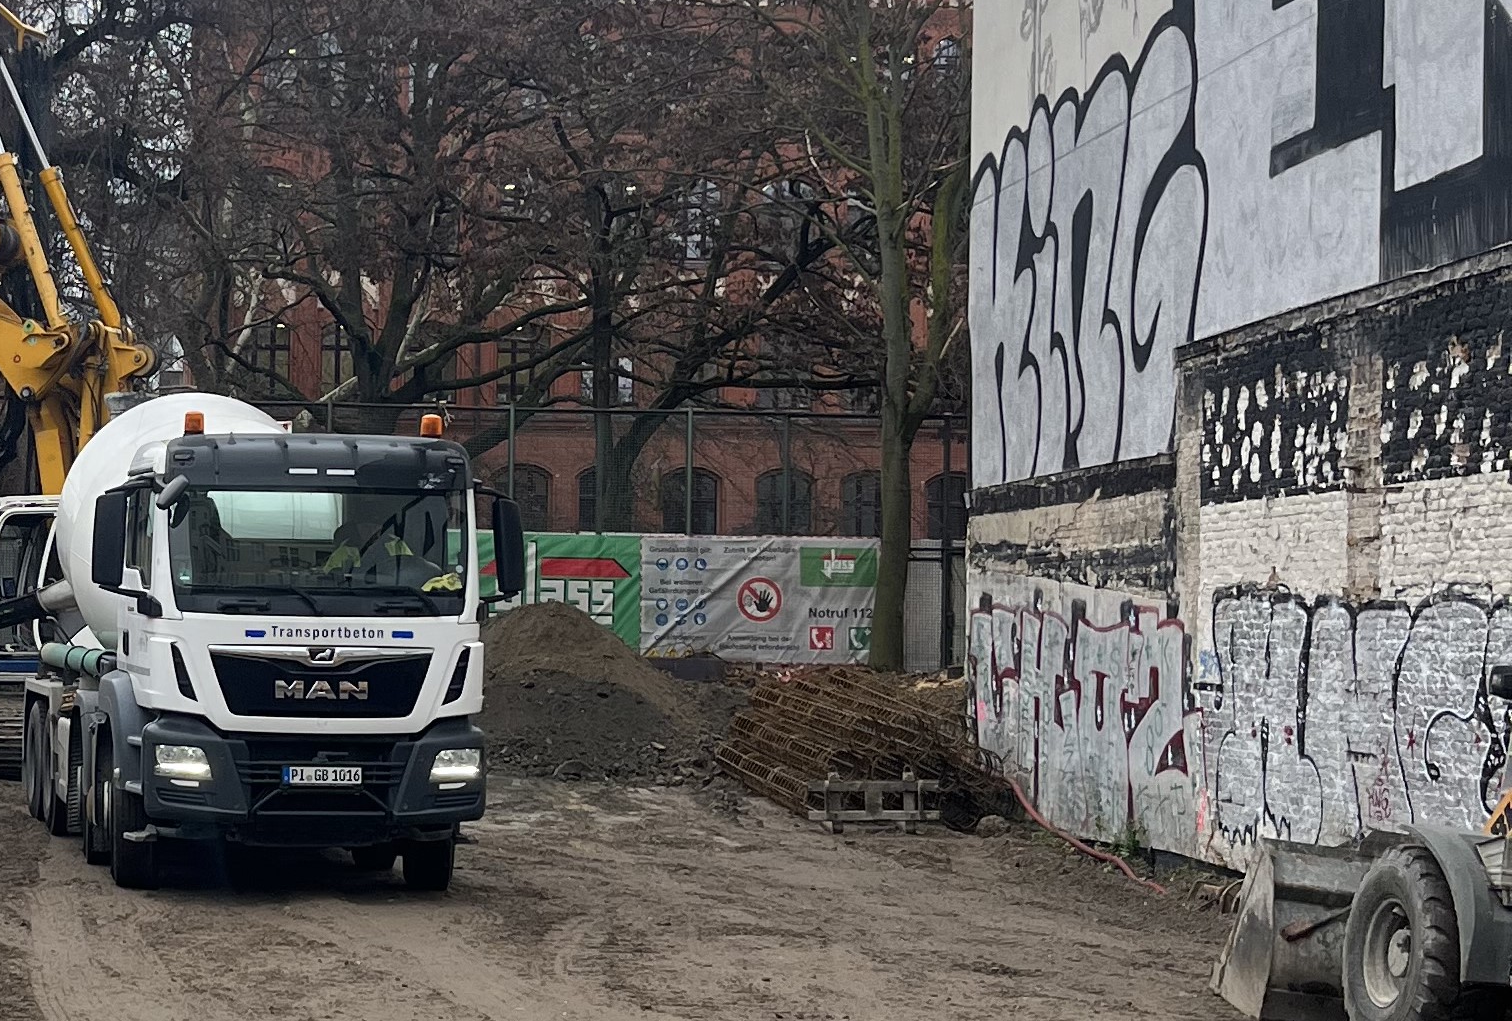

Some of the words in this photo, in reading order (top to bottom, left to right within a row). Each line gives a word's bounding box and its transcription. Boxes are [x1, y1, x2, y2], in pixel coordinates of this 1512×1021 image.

[808, 607, 849, 619] Notruf
[852, 608, 873, 619] 112
[271, 625, 384, 640] Transportbeton
[274, 680, 369, 700] MAN
[291, 768, 305, 781] PI
[314, 768, 329, 781] GB
[331, 768, 360, 781] 1016
